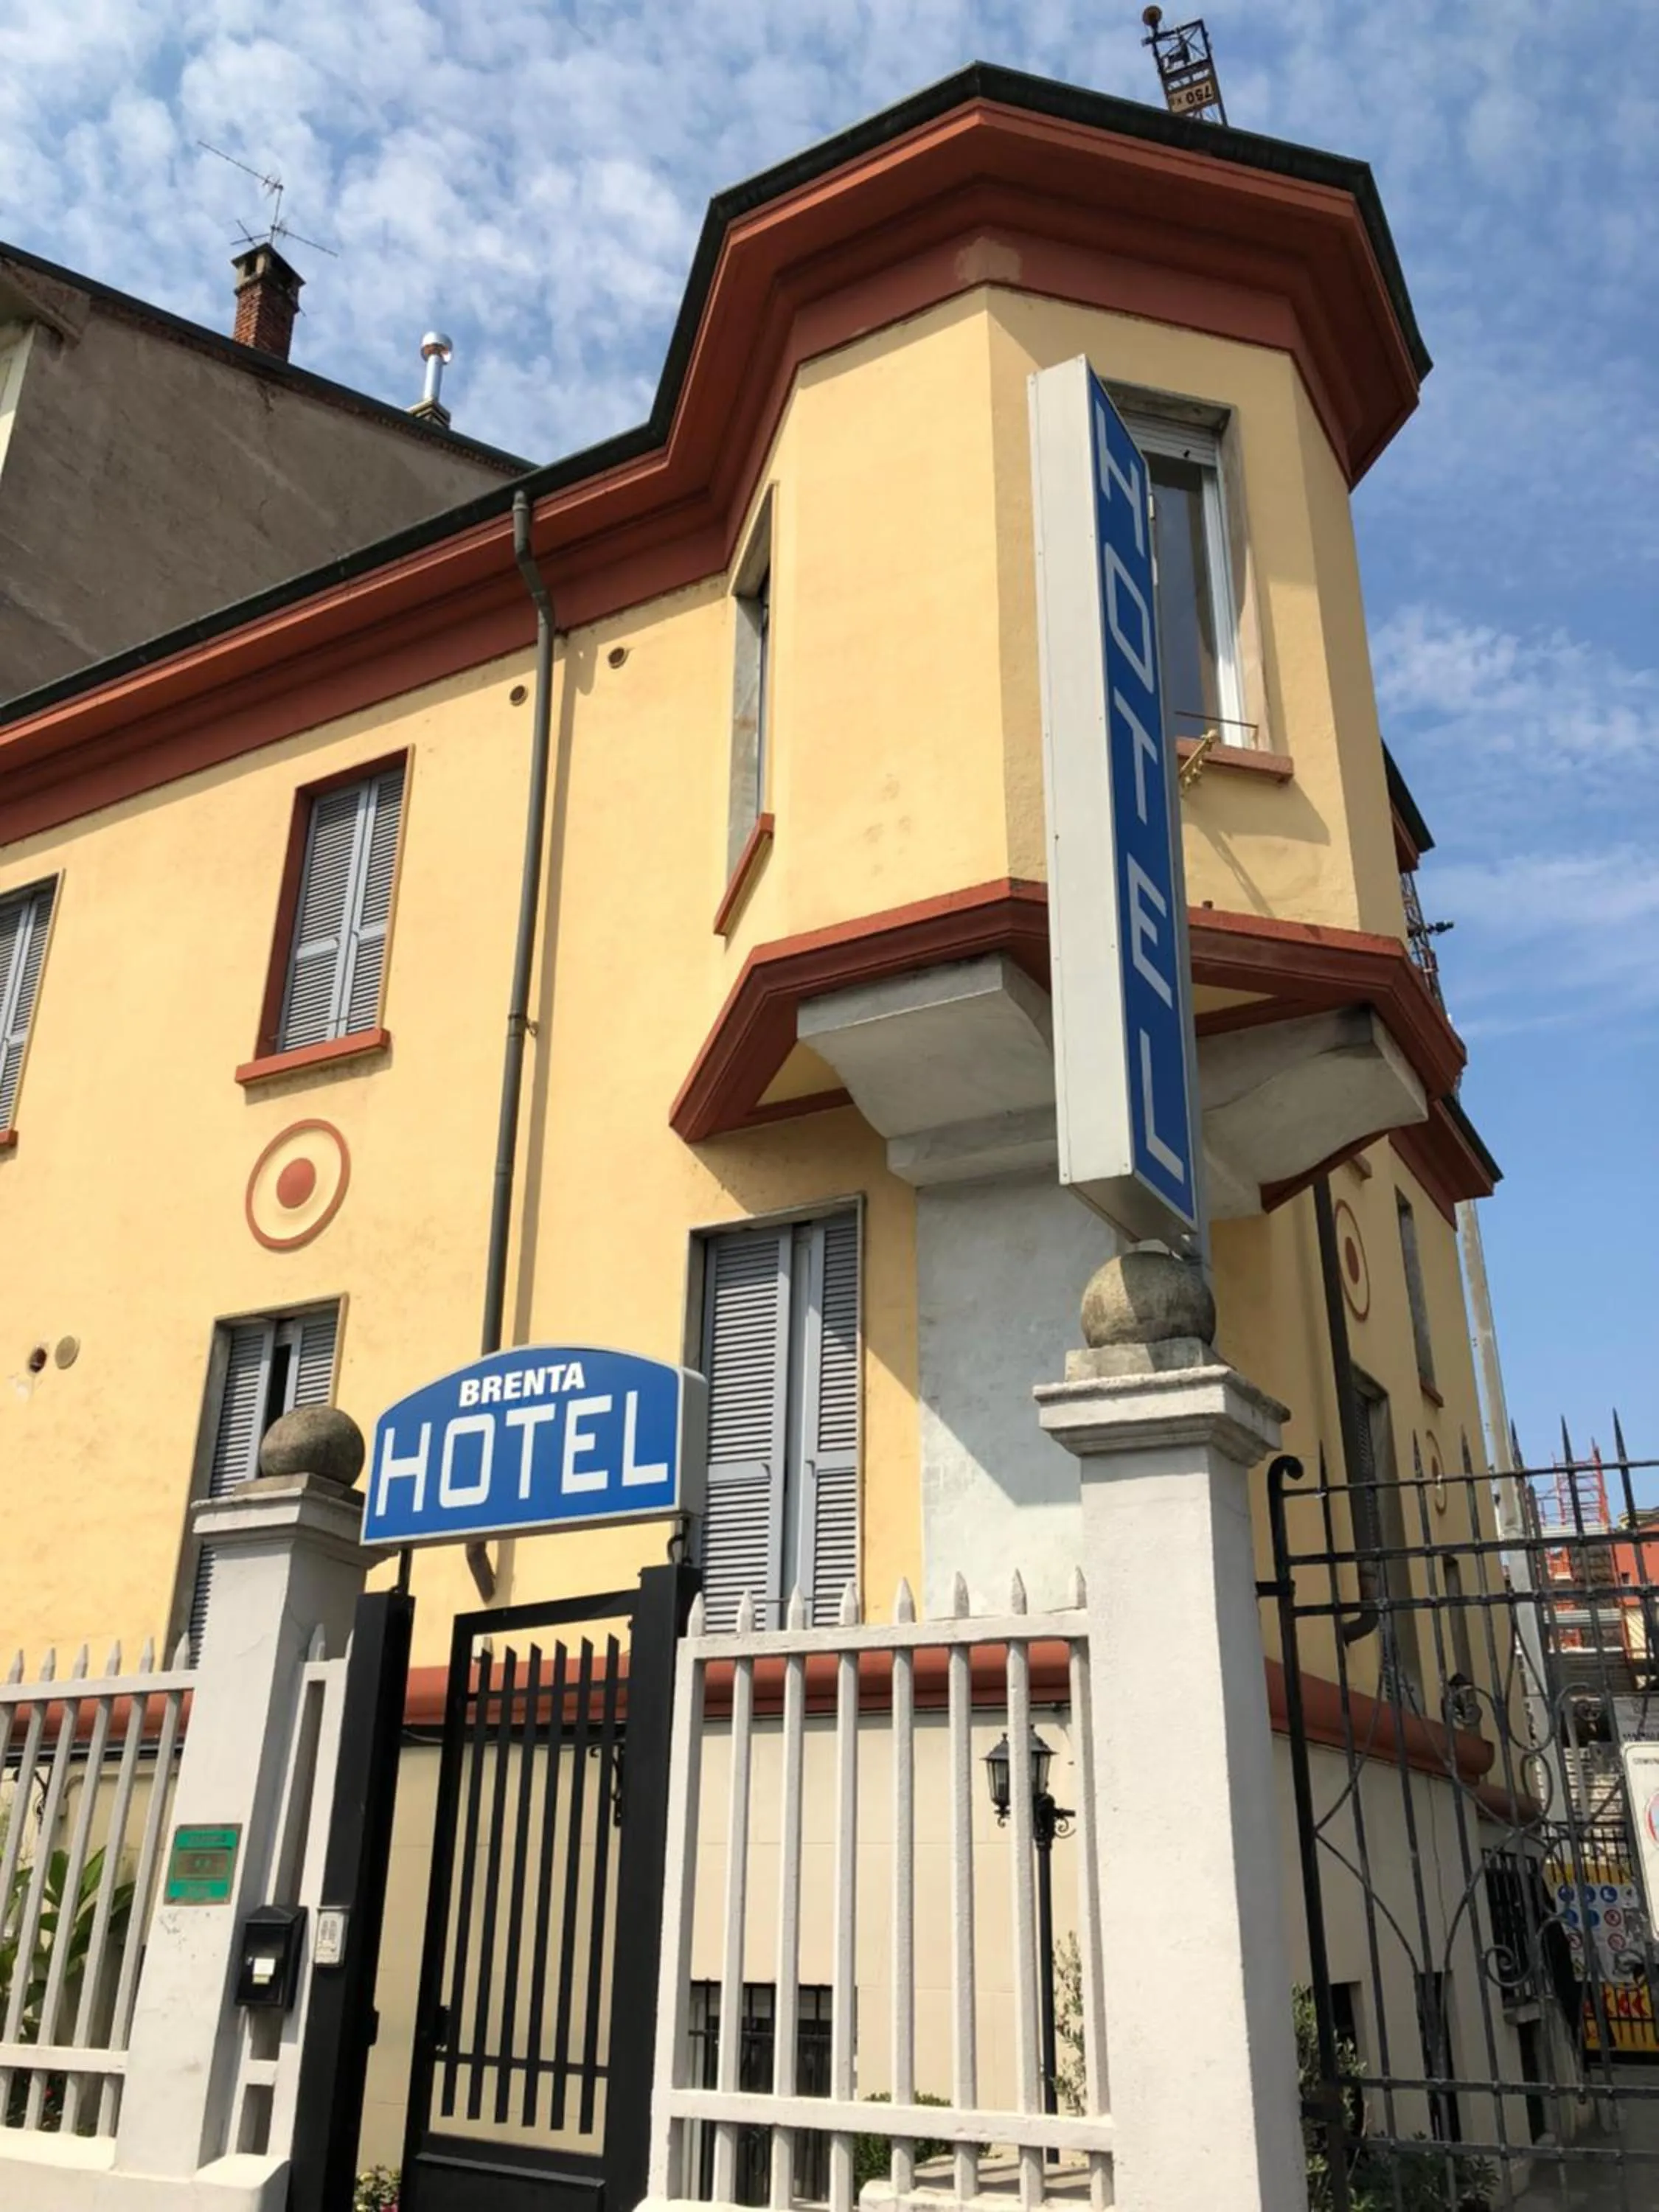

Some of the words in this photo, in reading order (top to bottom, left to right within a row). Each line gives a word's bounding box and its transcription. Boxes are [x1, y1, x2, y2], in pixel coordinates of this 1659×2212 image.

[1095, 400, 1184, 1185] HOTEL
[459, 1362, 585, 1408] BRENTA
[375, 1391, 668, 1516] HOTEL
